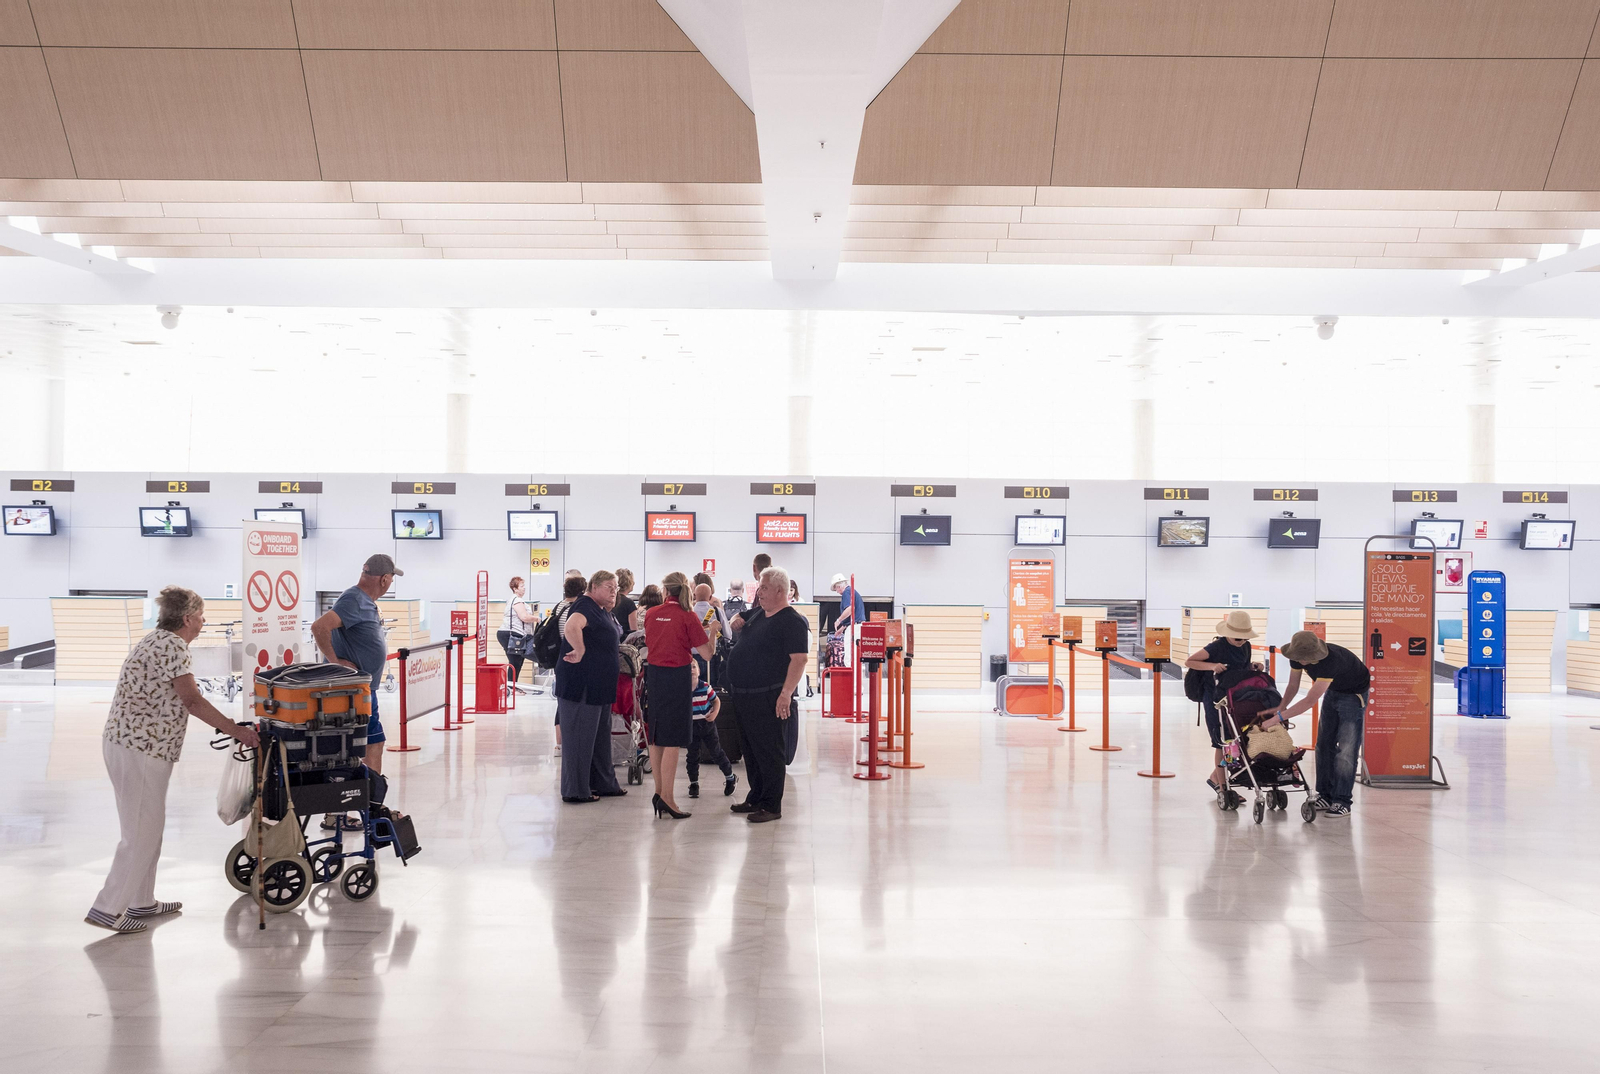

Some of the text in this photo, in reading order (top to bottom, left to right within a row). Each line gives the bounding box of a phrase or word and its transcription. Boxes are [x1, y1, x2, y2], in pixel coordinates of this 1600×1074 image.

[44, 481, 52, 491] 2
[179, 482, 188, 492] 3
[292, 481, 300, 493] 4
[426, 483, 433, 493] 5
[540, 485, 548, 495] 6
[676, 484, 684, 495] 7
[785, 484, 793, 494] 8
[926, 485, 934, 496] 9
[1035, 487, 1050, 498] 10
[1175, 489, 1190, 500] 11
[1285, 490, 1299, 500] 12
[1424, 491, 1438, 502] 13
[1534, 492, 1548, 502] 14
[263, 534, 291, 543] ONBOARD
[267, 544, 297, 553] TOGETHER
[1371, 564, 1404, 574] ¿SOLO
[1371, 574, 1407, 583] LLEVAS
[1371, 584, 1417, 593] EQUIPAJE
[1371, 594, 1425, 603] DE MANO?
